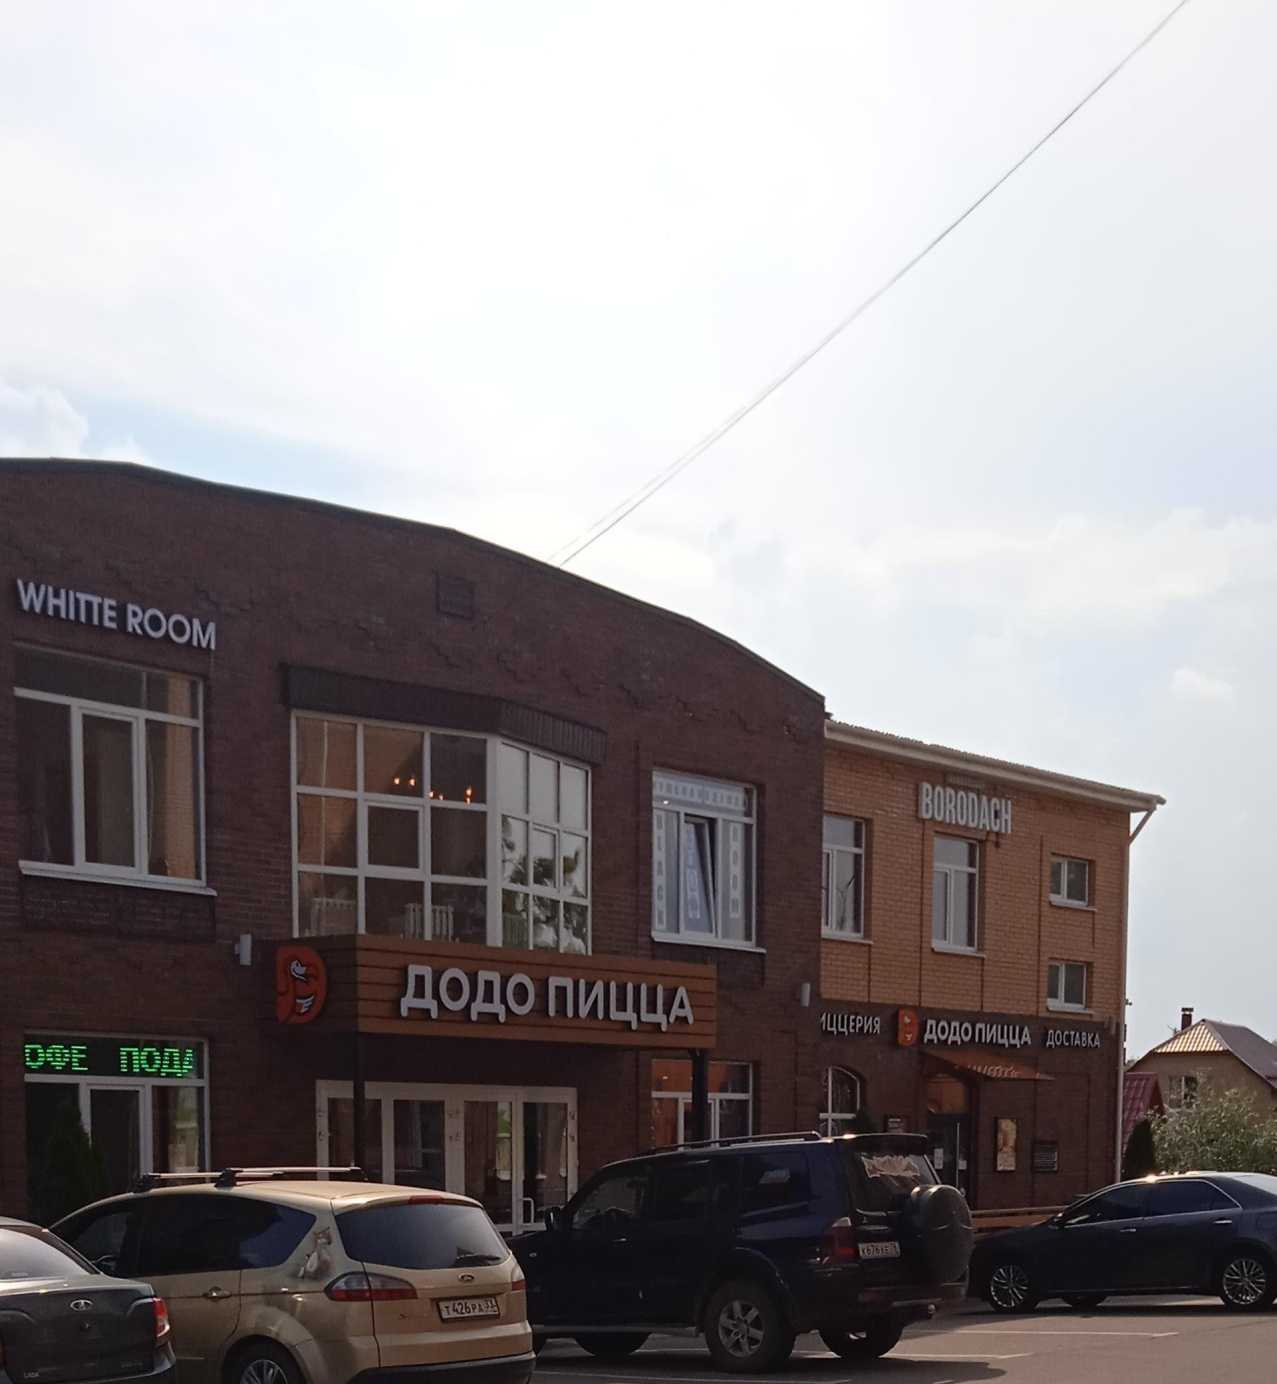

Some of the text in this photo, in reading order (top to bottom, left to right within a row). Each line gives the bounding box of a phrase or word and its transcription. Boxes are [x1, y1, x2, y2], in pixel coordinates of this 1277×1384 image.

[17, 578, 217, 651] WHITTE ROOM
[920, 782, 1012, 834] BORODACH
[400, 964, 694, 1032] ДОДО ПИЦЦА
[923, 1018, 1032, 1049] ДОДО ПИЦЦА
[1046, 1029, 1101, 1049] ДОСТАВКА
